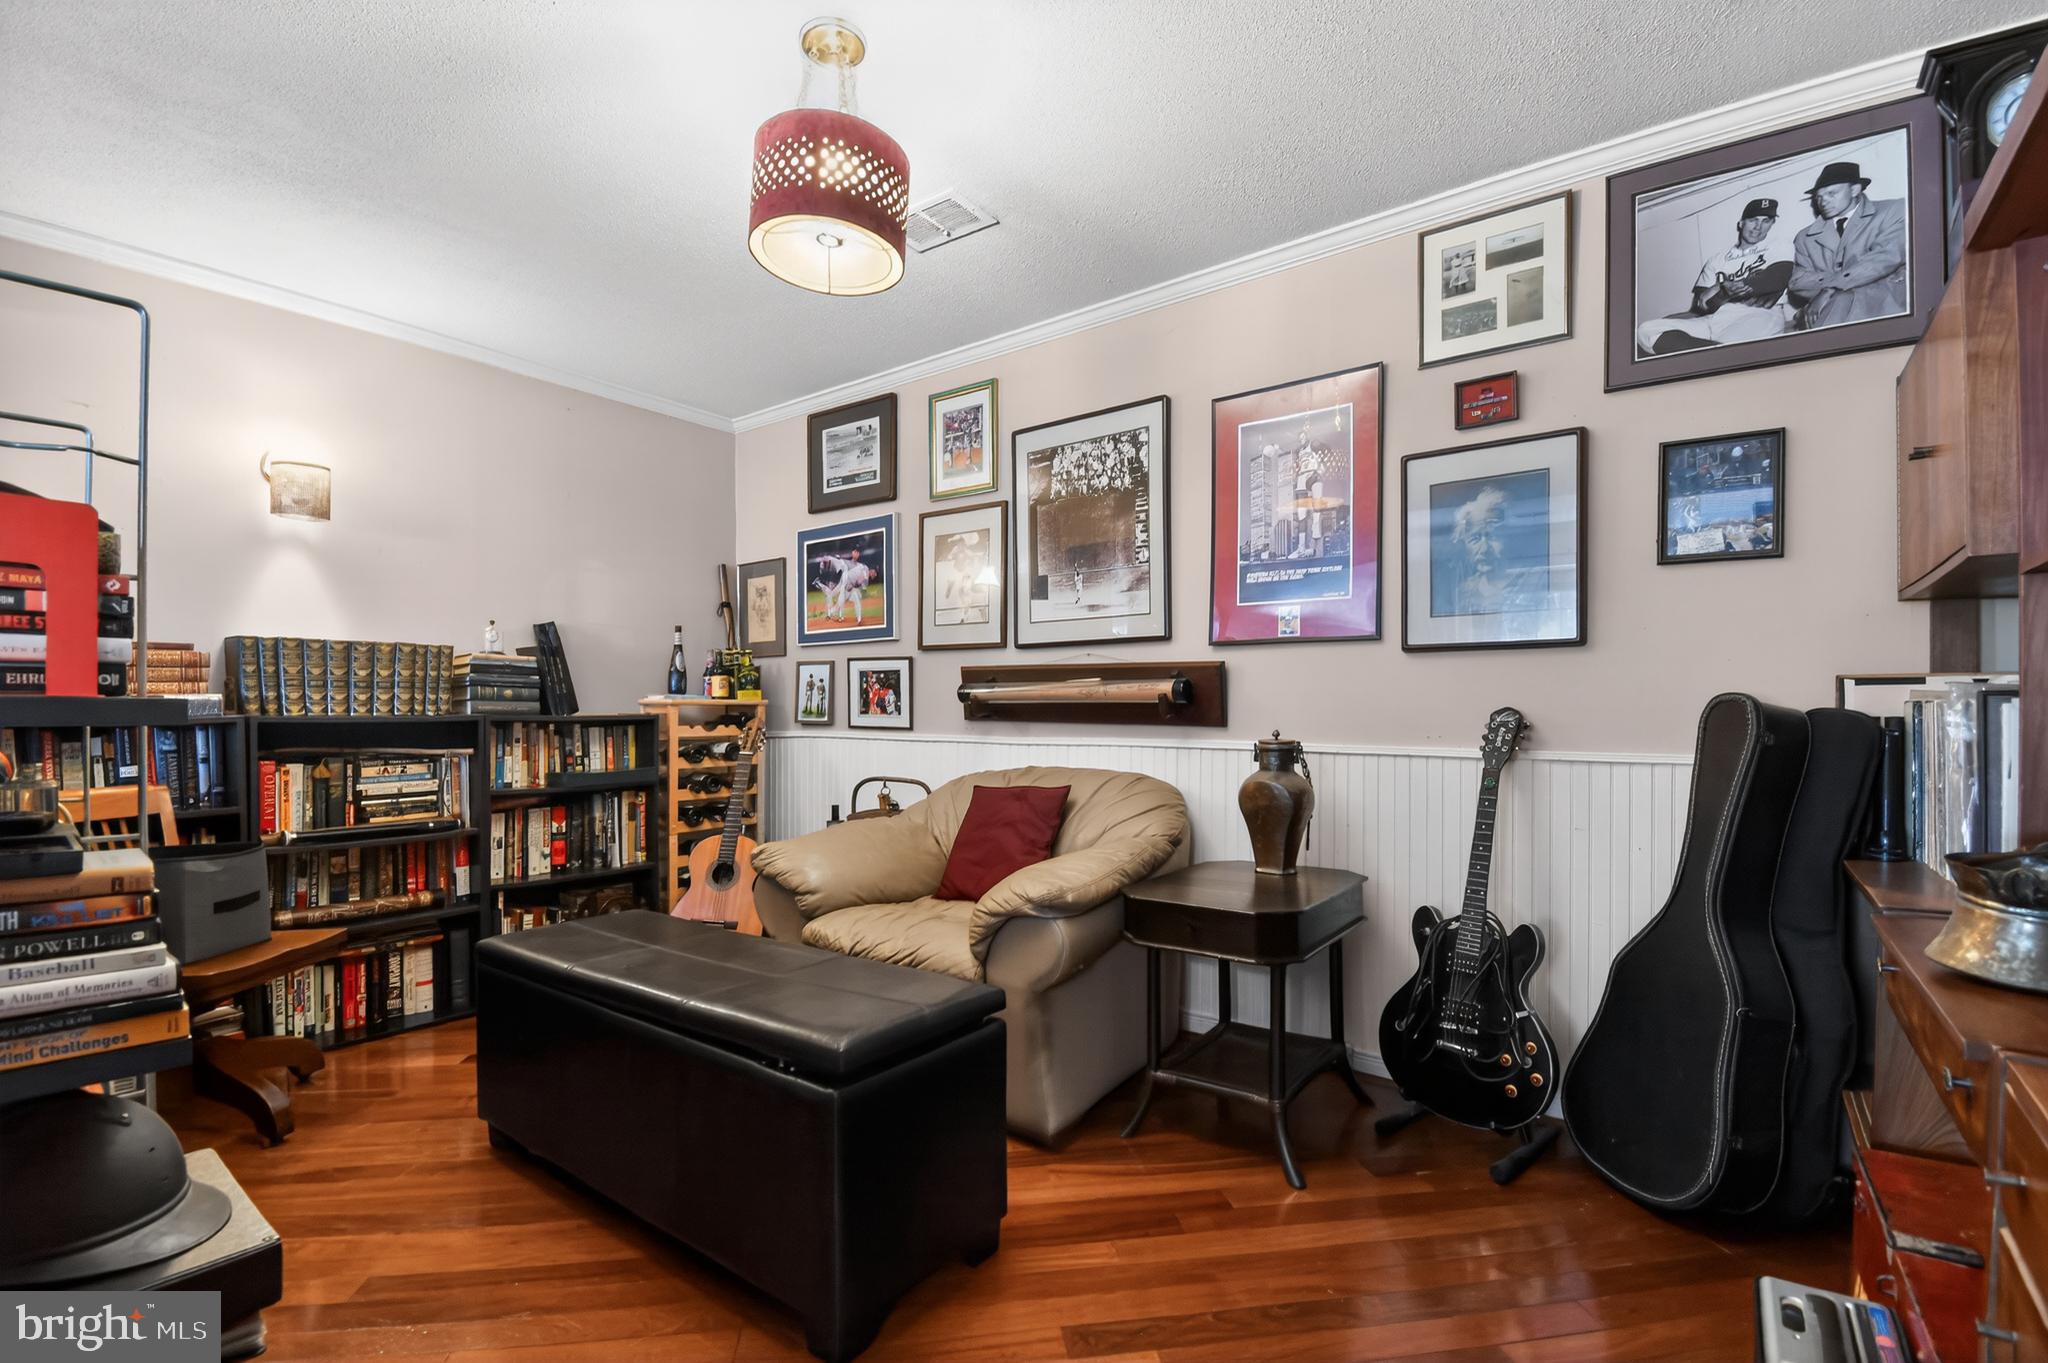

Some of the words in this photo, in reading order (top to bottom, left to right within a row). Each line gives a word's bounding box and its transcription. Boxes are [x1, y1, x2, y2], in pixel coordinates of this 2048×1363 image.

[14, 934, 107, 958] POWELL
[8, 957, 96, 980] Baseball
[10, 990, 54, 1004] Album
[57, 984, 70, 997] of
[75, 979, 134, 995] Memories
[39, 1033, 129, 1058] Challenges
